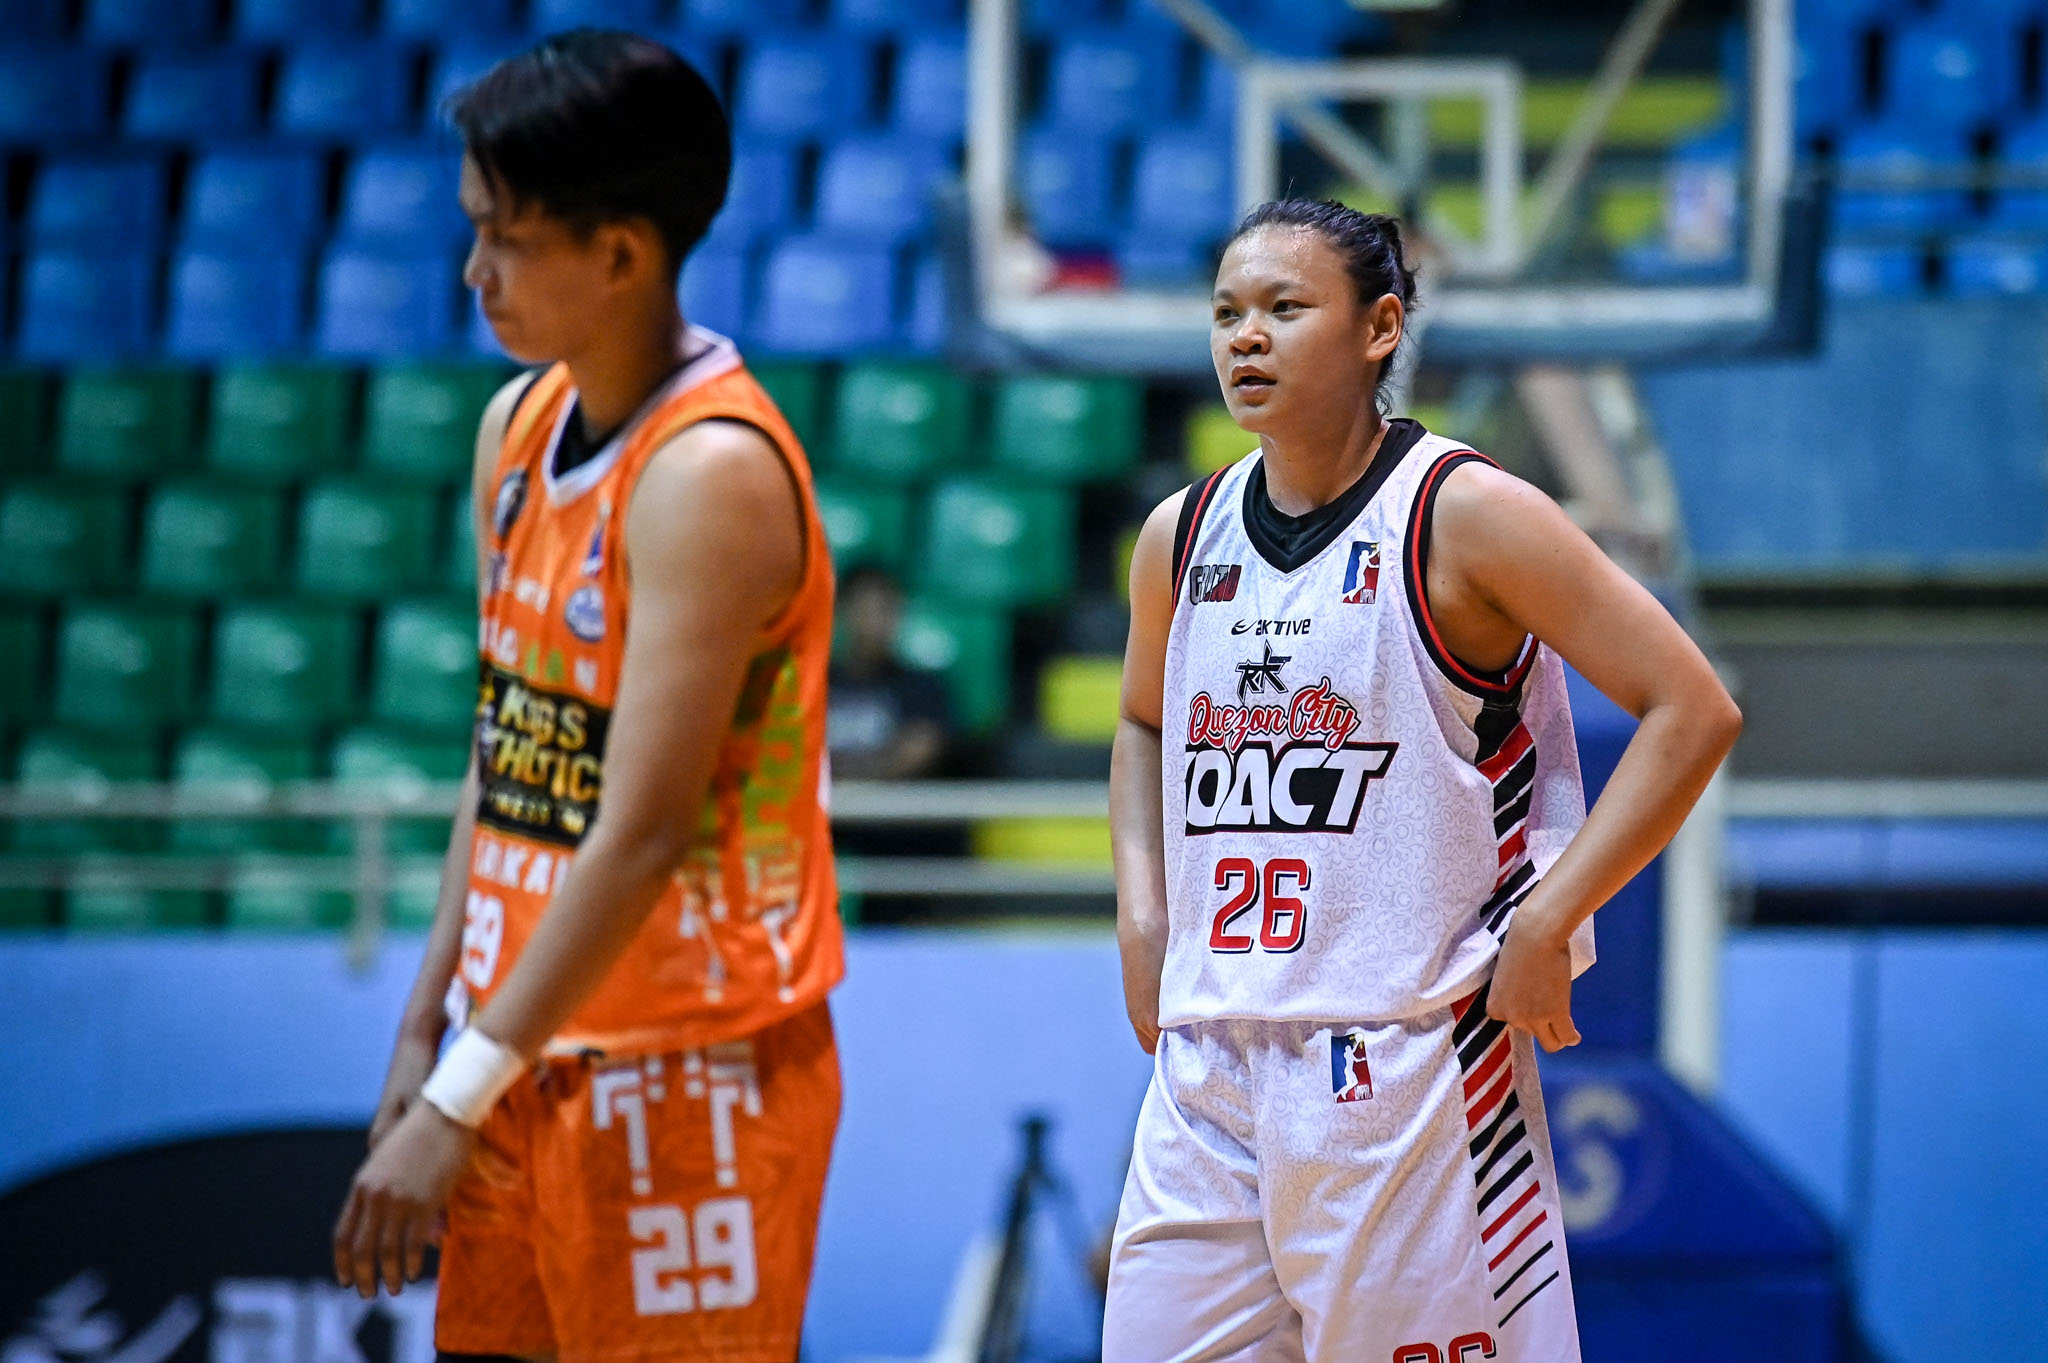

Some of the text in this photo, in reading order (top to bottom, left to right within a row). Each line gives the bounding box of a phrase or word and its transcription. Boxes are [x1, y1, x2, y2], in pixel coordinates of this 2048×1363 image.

[1187, 676, 1361, 753] Quezon City
[1186, 747, 1392, 830] OACT
[1209, 857, 1312, 955] 26
[627, 1196, 759, 1317] 29
